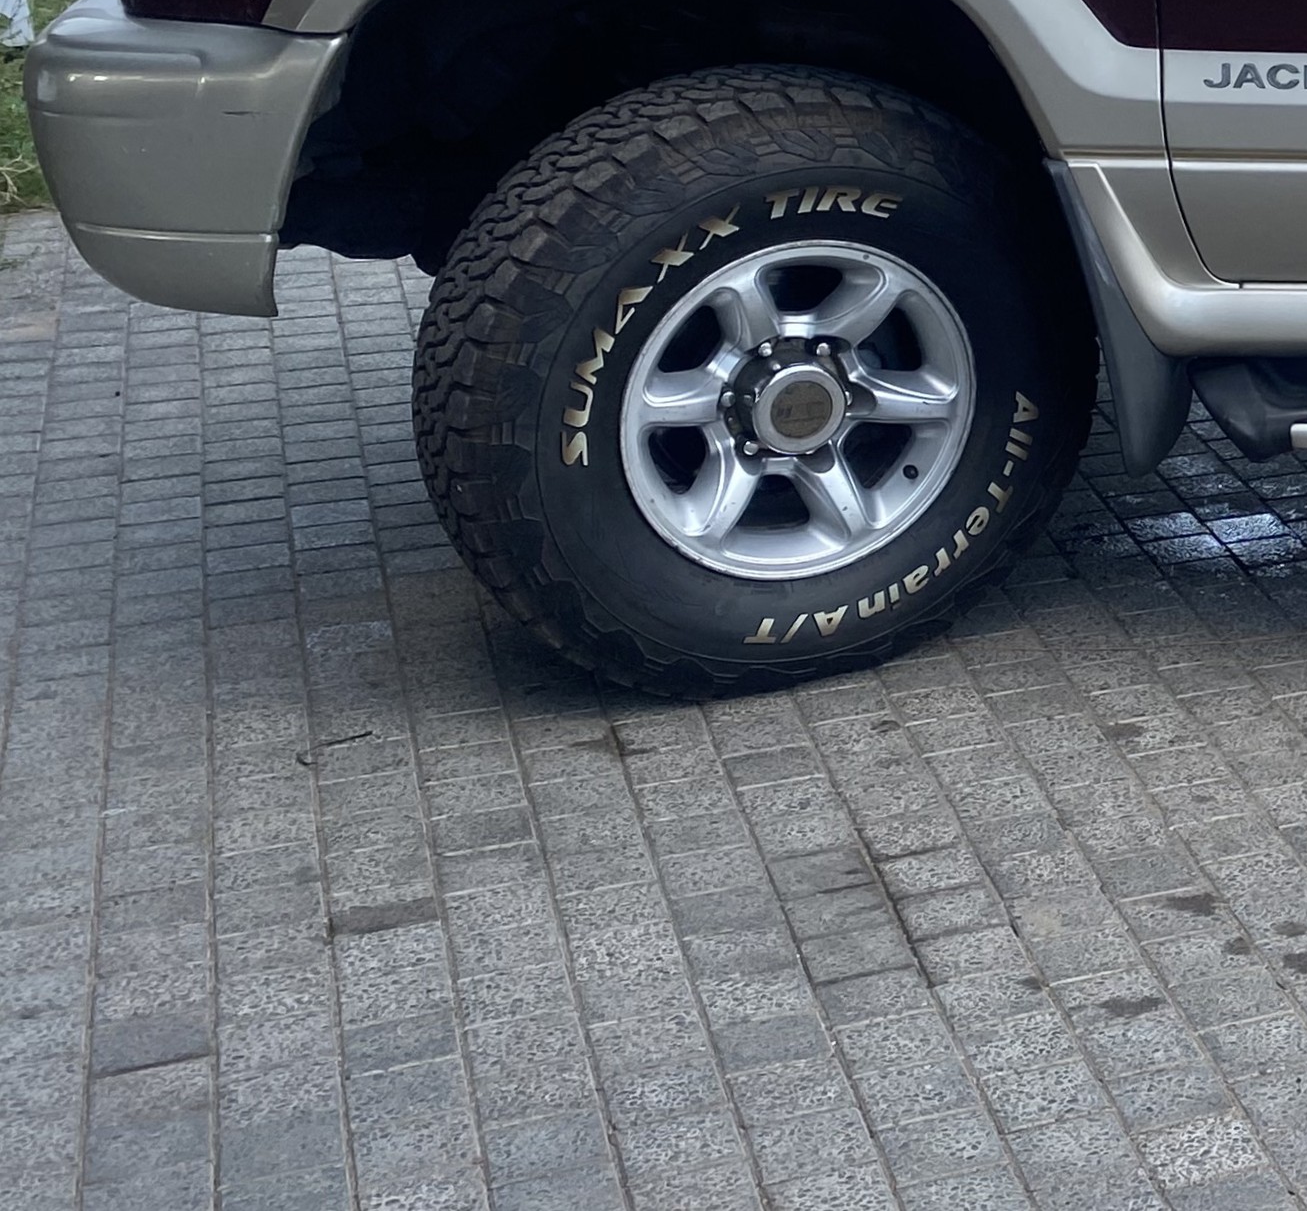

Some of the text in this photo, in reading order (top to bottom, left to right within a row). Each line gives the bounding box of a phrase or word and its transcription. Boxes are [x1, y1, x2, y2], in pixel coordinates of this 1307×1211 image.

[560, 186, 904, 468] SUMAXX TIRE
[742, 390, 1040, 645] All-Terrain A/T
